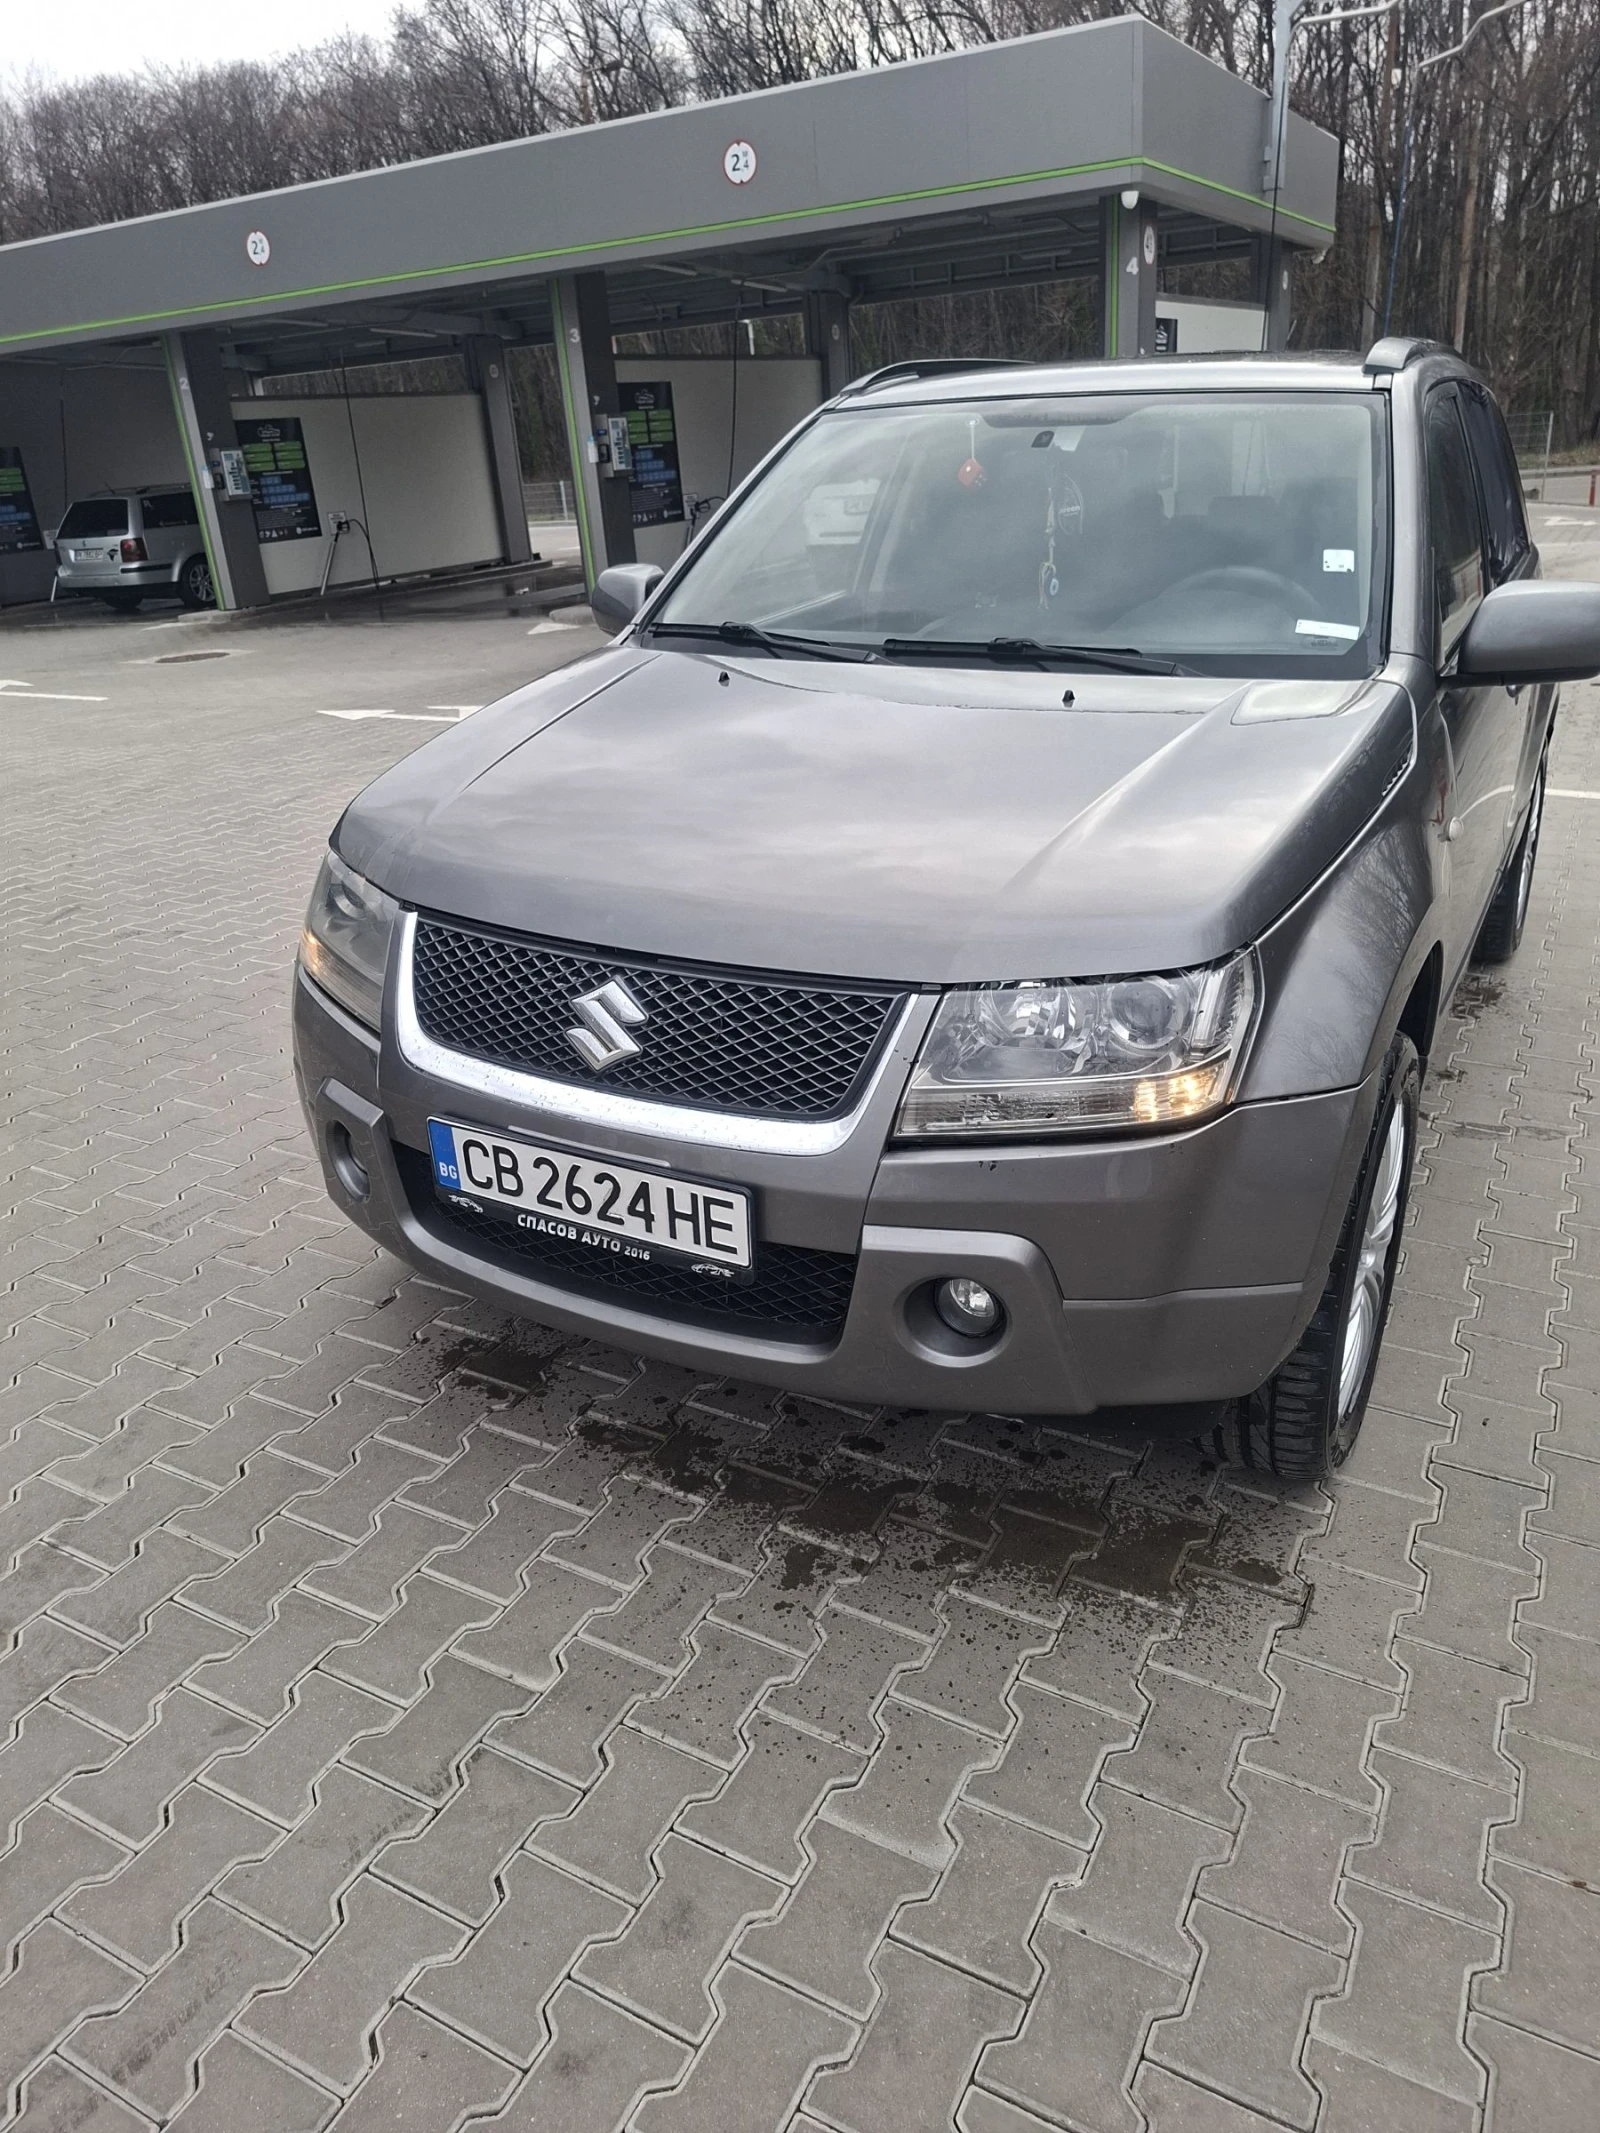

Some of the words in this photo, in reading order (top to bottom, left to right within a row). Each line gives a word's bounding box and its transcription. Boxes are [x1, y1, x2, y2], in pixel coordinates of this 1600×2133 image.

[1125, 256, 1140, 276] 4
[569, 327, 581, 344] 3
[179, 377, 190, 390] 2
[438, 1161, 458, 1180] BG
[532, 1155, 656, 1234] 2624
[516, 1213, 577, 1241] СПАСОВ
[581, 1231, 621, 1253] АУТО
[624, 1245, 651, 1261] 2016
